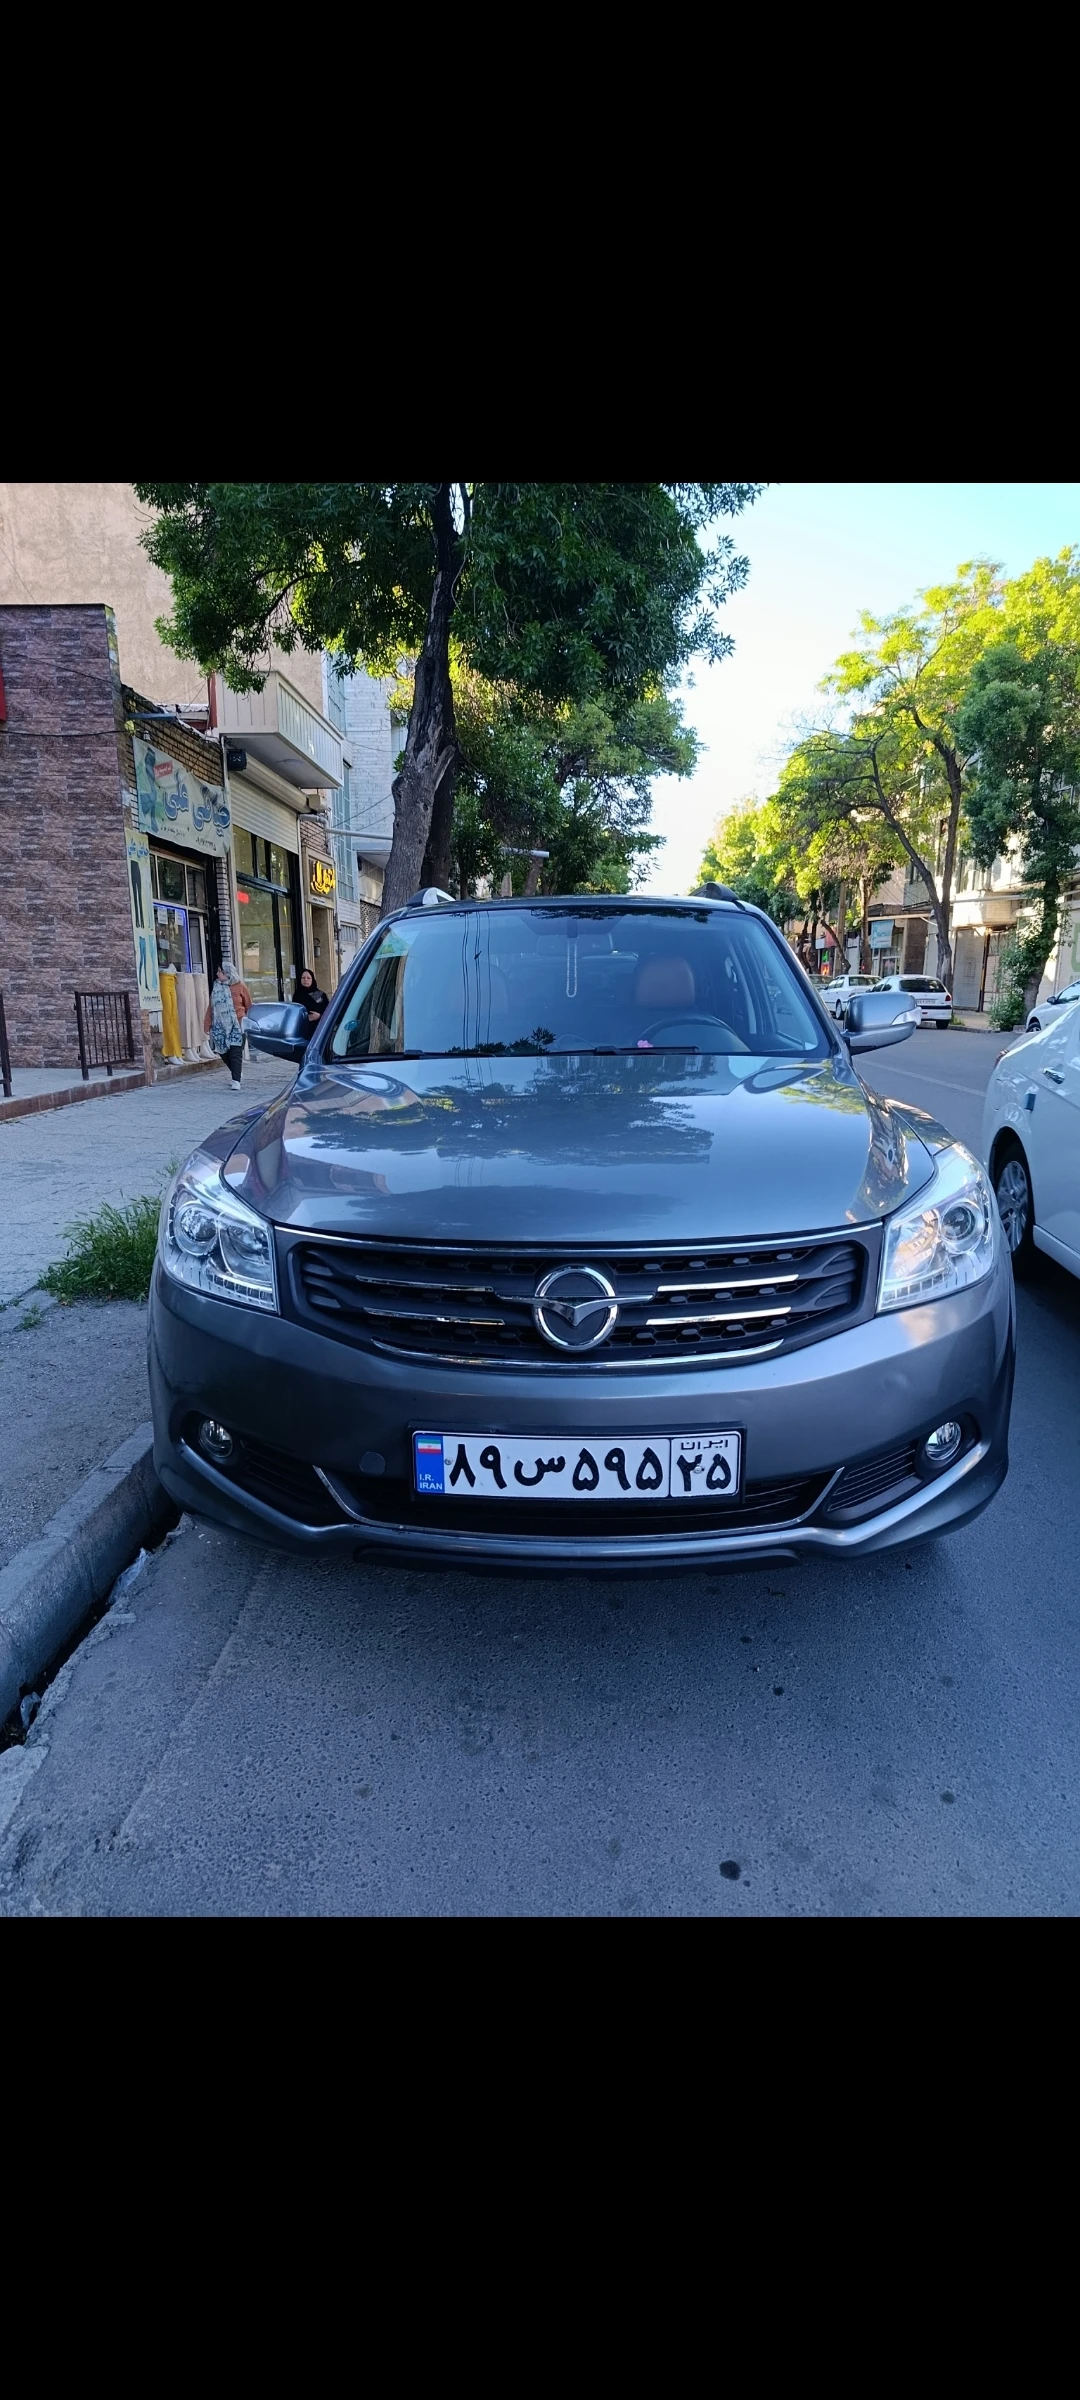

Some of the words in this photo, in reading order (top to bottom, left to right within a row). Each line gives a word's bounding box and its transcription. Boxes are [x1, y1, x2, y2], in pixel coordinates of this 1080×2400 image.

[163, 769, 189, 820] علی
[680, 1439, 729, 1450] ایران
[419, 1473, 434, 1481] I.R.
[676, 1453, 732, 1492] ۲۵
[419, 1482, 443, 1490] IRAN
